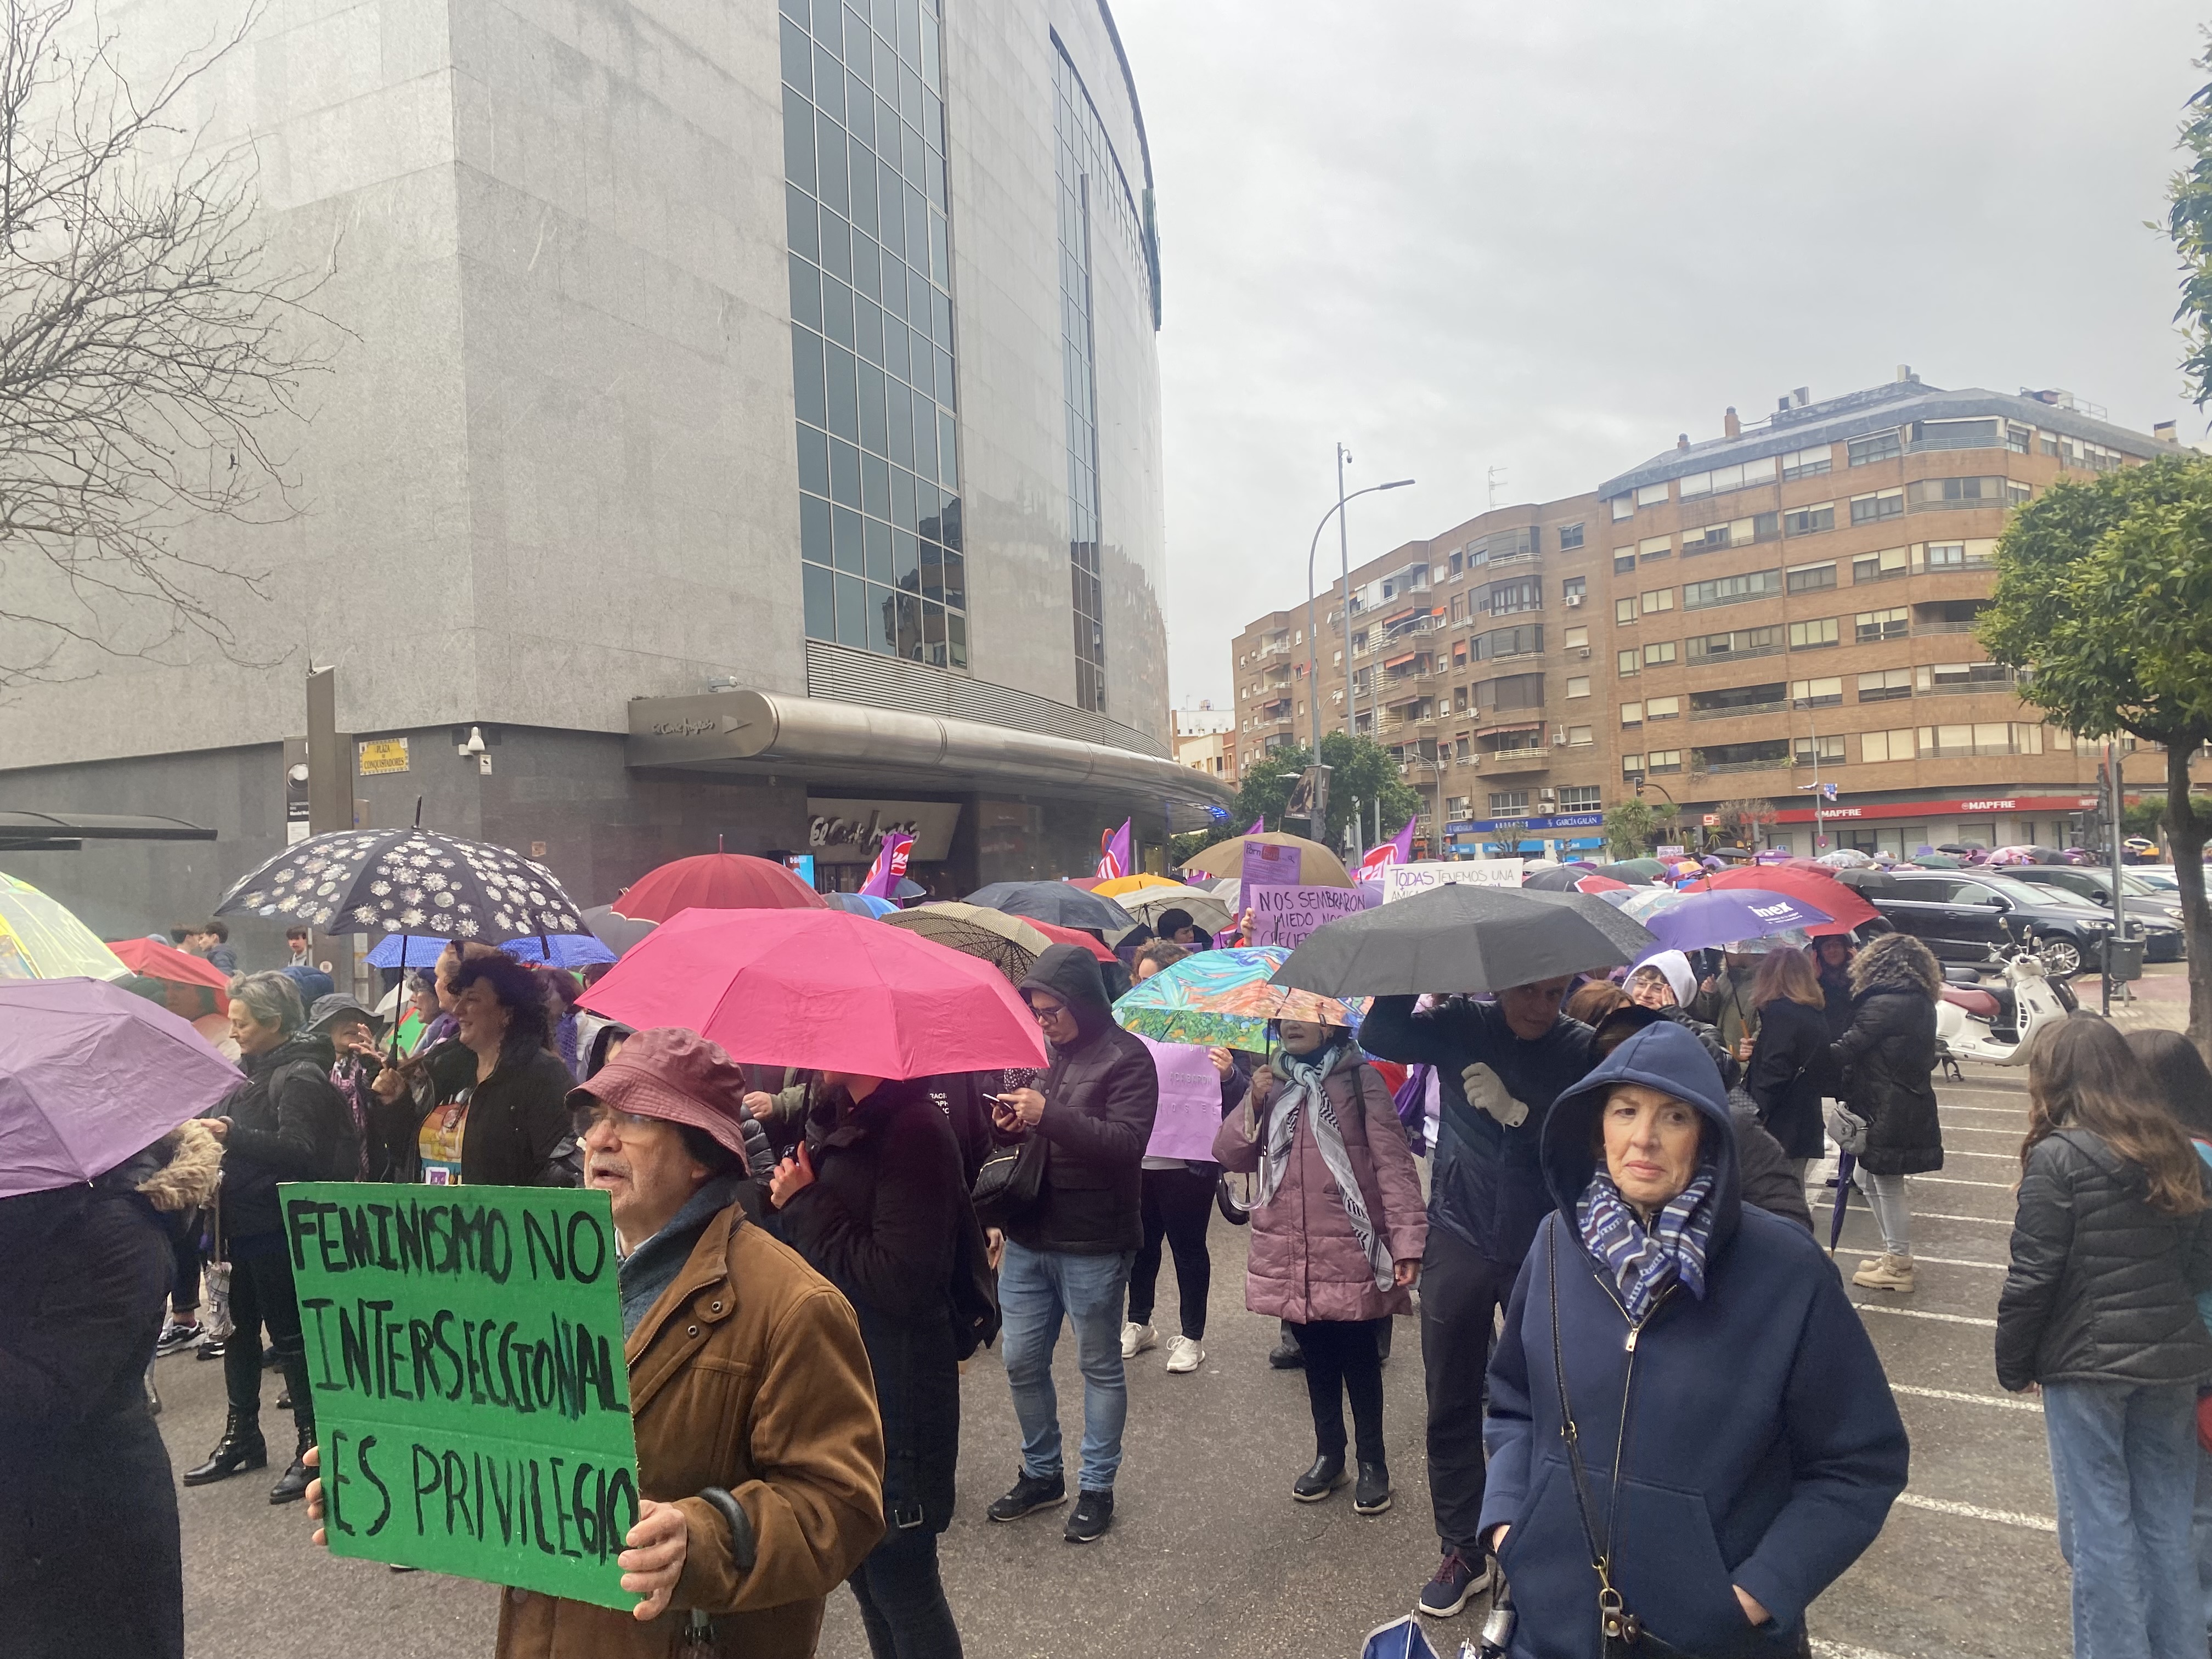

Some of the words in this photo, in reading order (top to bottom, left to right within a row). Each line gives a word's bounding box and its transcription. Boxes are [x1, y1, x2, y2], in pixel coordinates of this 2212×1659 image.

[376, 744, 390, 753] PLAZA
[364, 758, 404, 770] CONQUISTADORES
[1969, 800, 2016, 809] MAPFRE
[1821, 809, 1862, 817] MAPFRE
[1556, 817, 1577, 826] GARCÍA
[1577, 816, 1597, 825] GALÁN
[1246, 843, 1261, 856] Porn
[1390, 868, 1434, 889] TODAS
[1436, 870, 1487, 884] TENEMOS
[1492, 869, 1514, 881] UNA
[1259, 891, 1294, 911] NOS
[1298, 891, 1365, 912] SEMBRARON
[1273, 912, 1314, 928] MIEDO
[286, 1197, 512, 1284] FEMINISMO
[523, 1209, 605, 1283] NO
[301, 1298, 631, 1421] INTERSECCIONAL
[332, 1430, 392, 1536] ES
[412, 1444, 640, 1566] PRIVILEGIO
